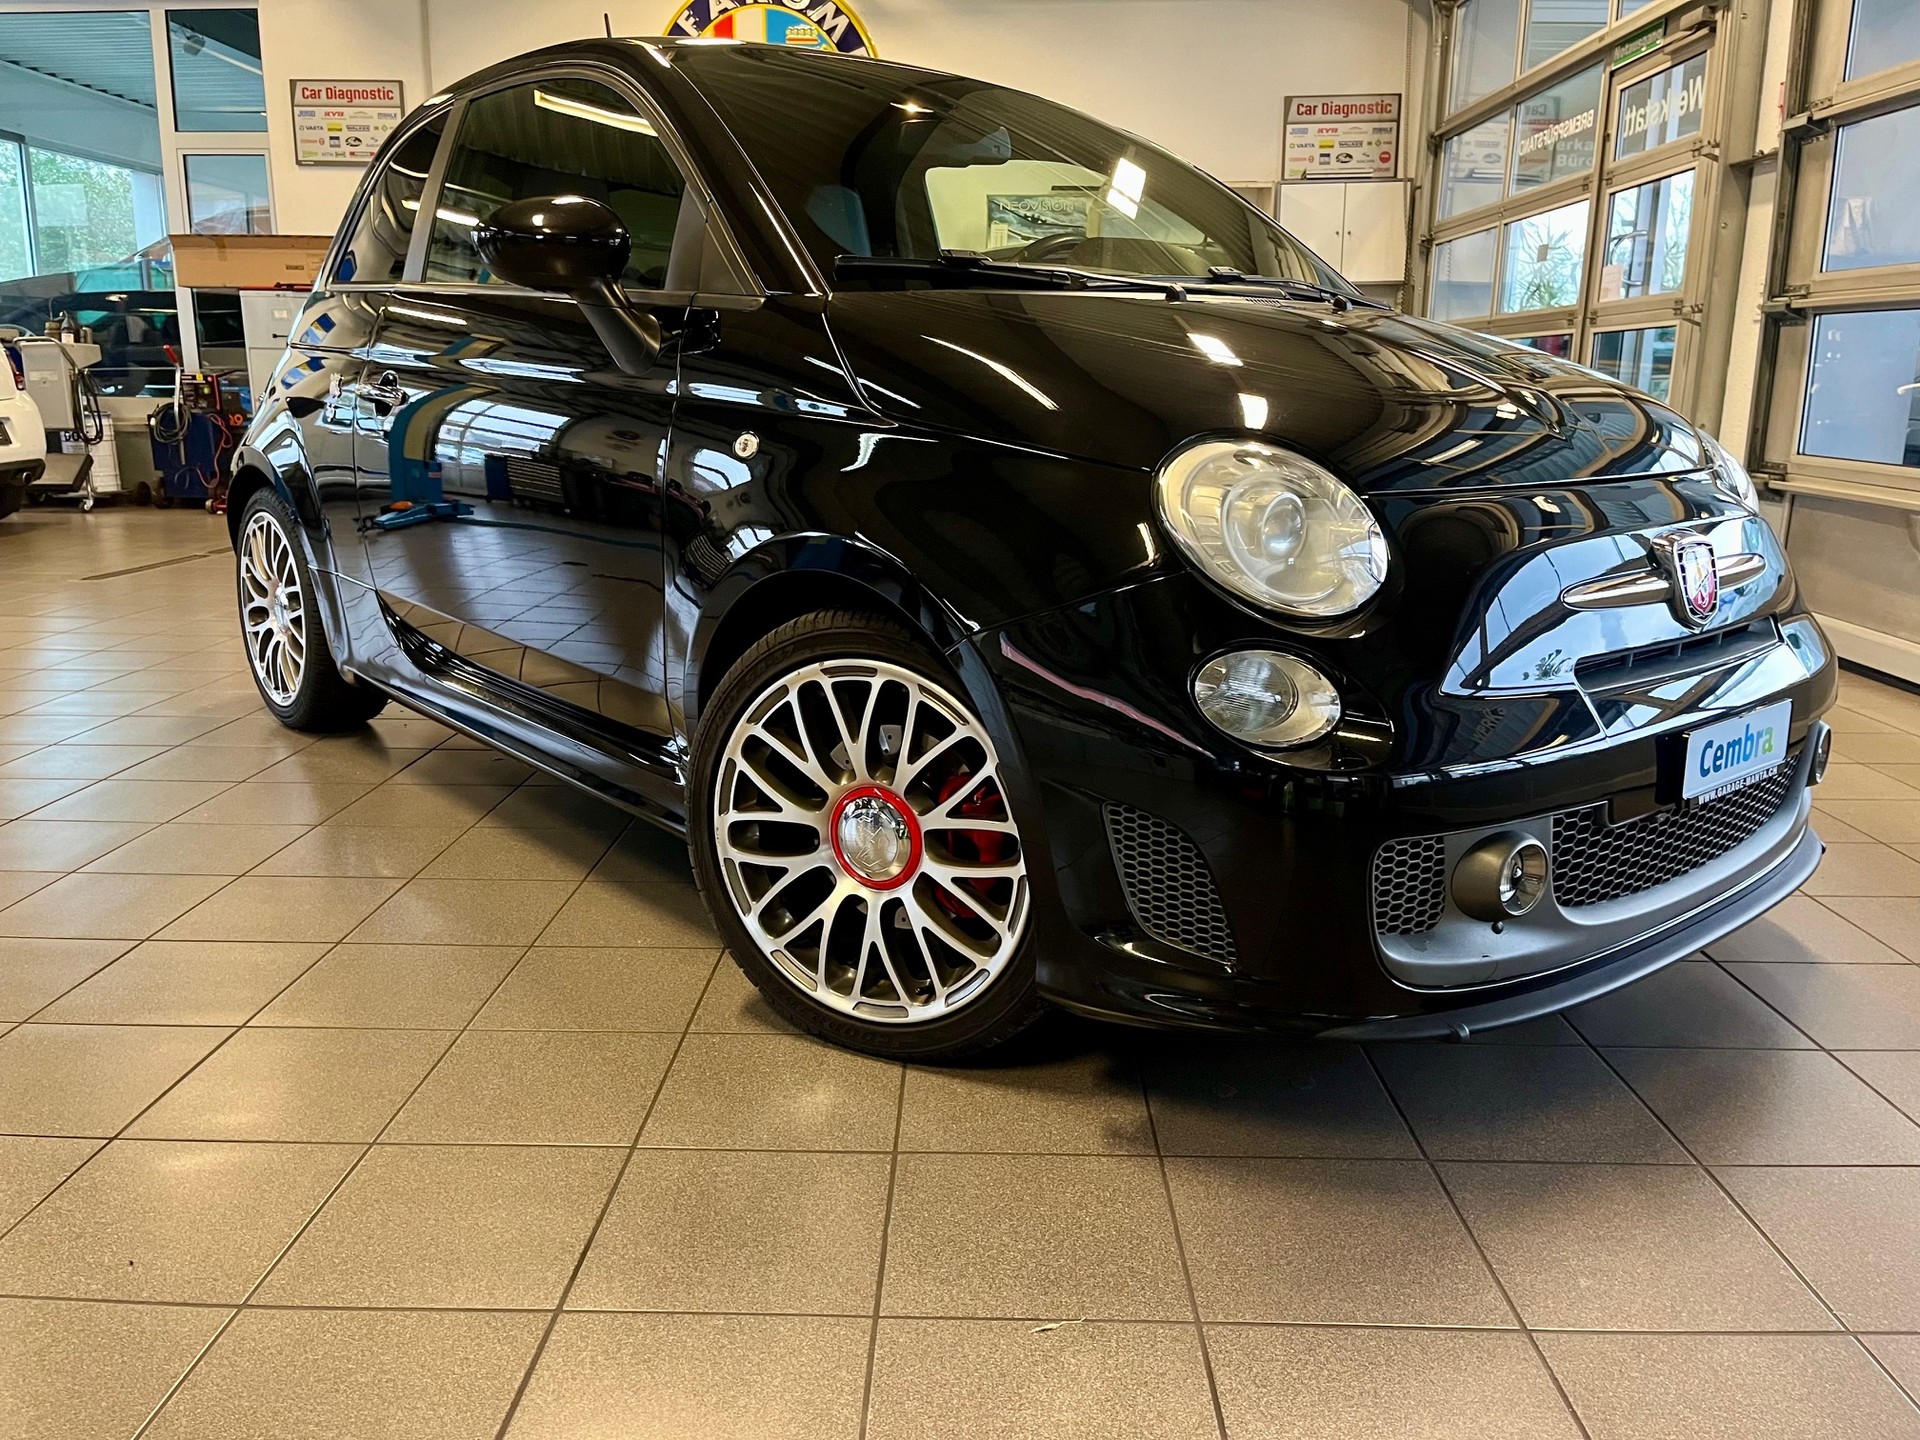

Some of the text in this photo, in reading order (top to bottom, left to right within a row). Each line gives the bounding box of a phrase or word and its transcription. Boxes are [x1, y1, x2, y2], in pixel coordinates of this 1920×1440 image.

[301, 86, 394, 103] Car Diagnostic
[1296, 100, 1392, 118] Car Diagnostic
[1000, 200, 1074, 212] NEOVISION
[1699, 723, 1774, 778] Cembra
[1698, 765, 1778, 805] WWW.GARAGE-MANTA.CH
